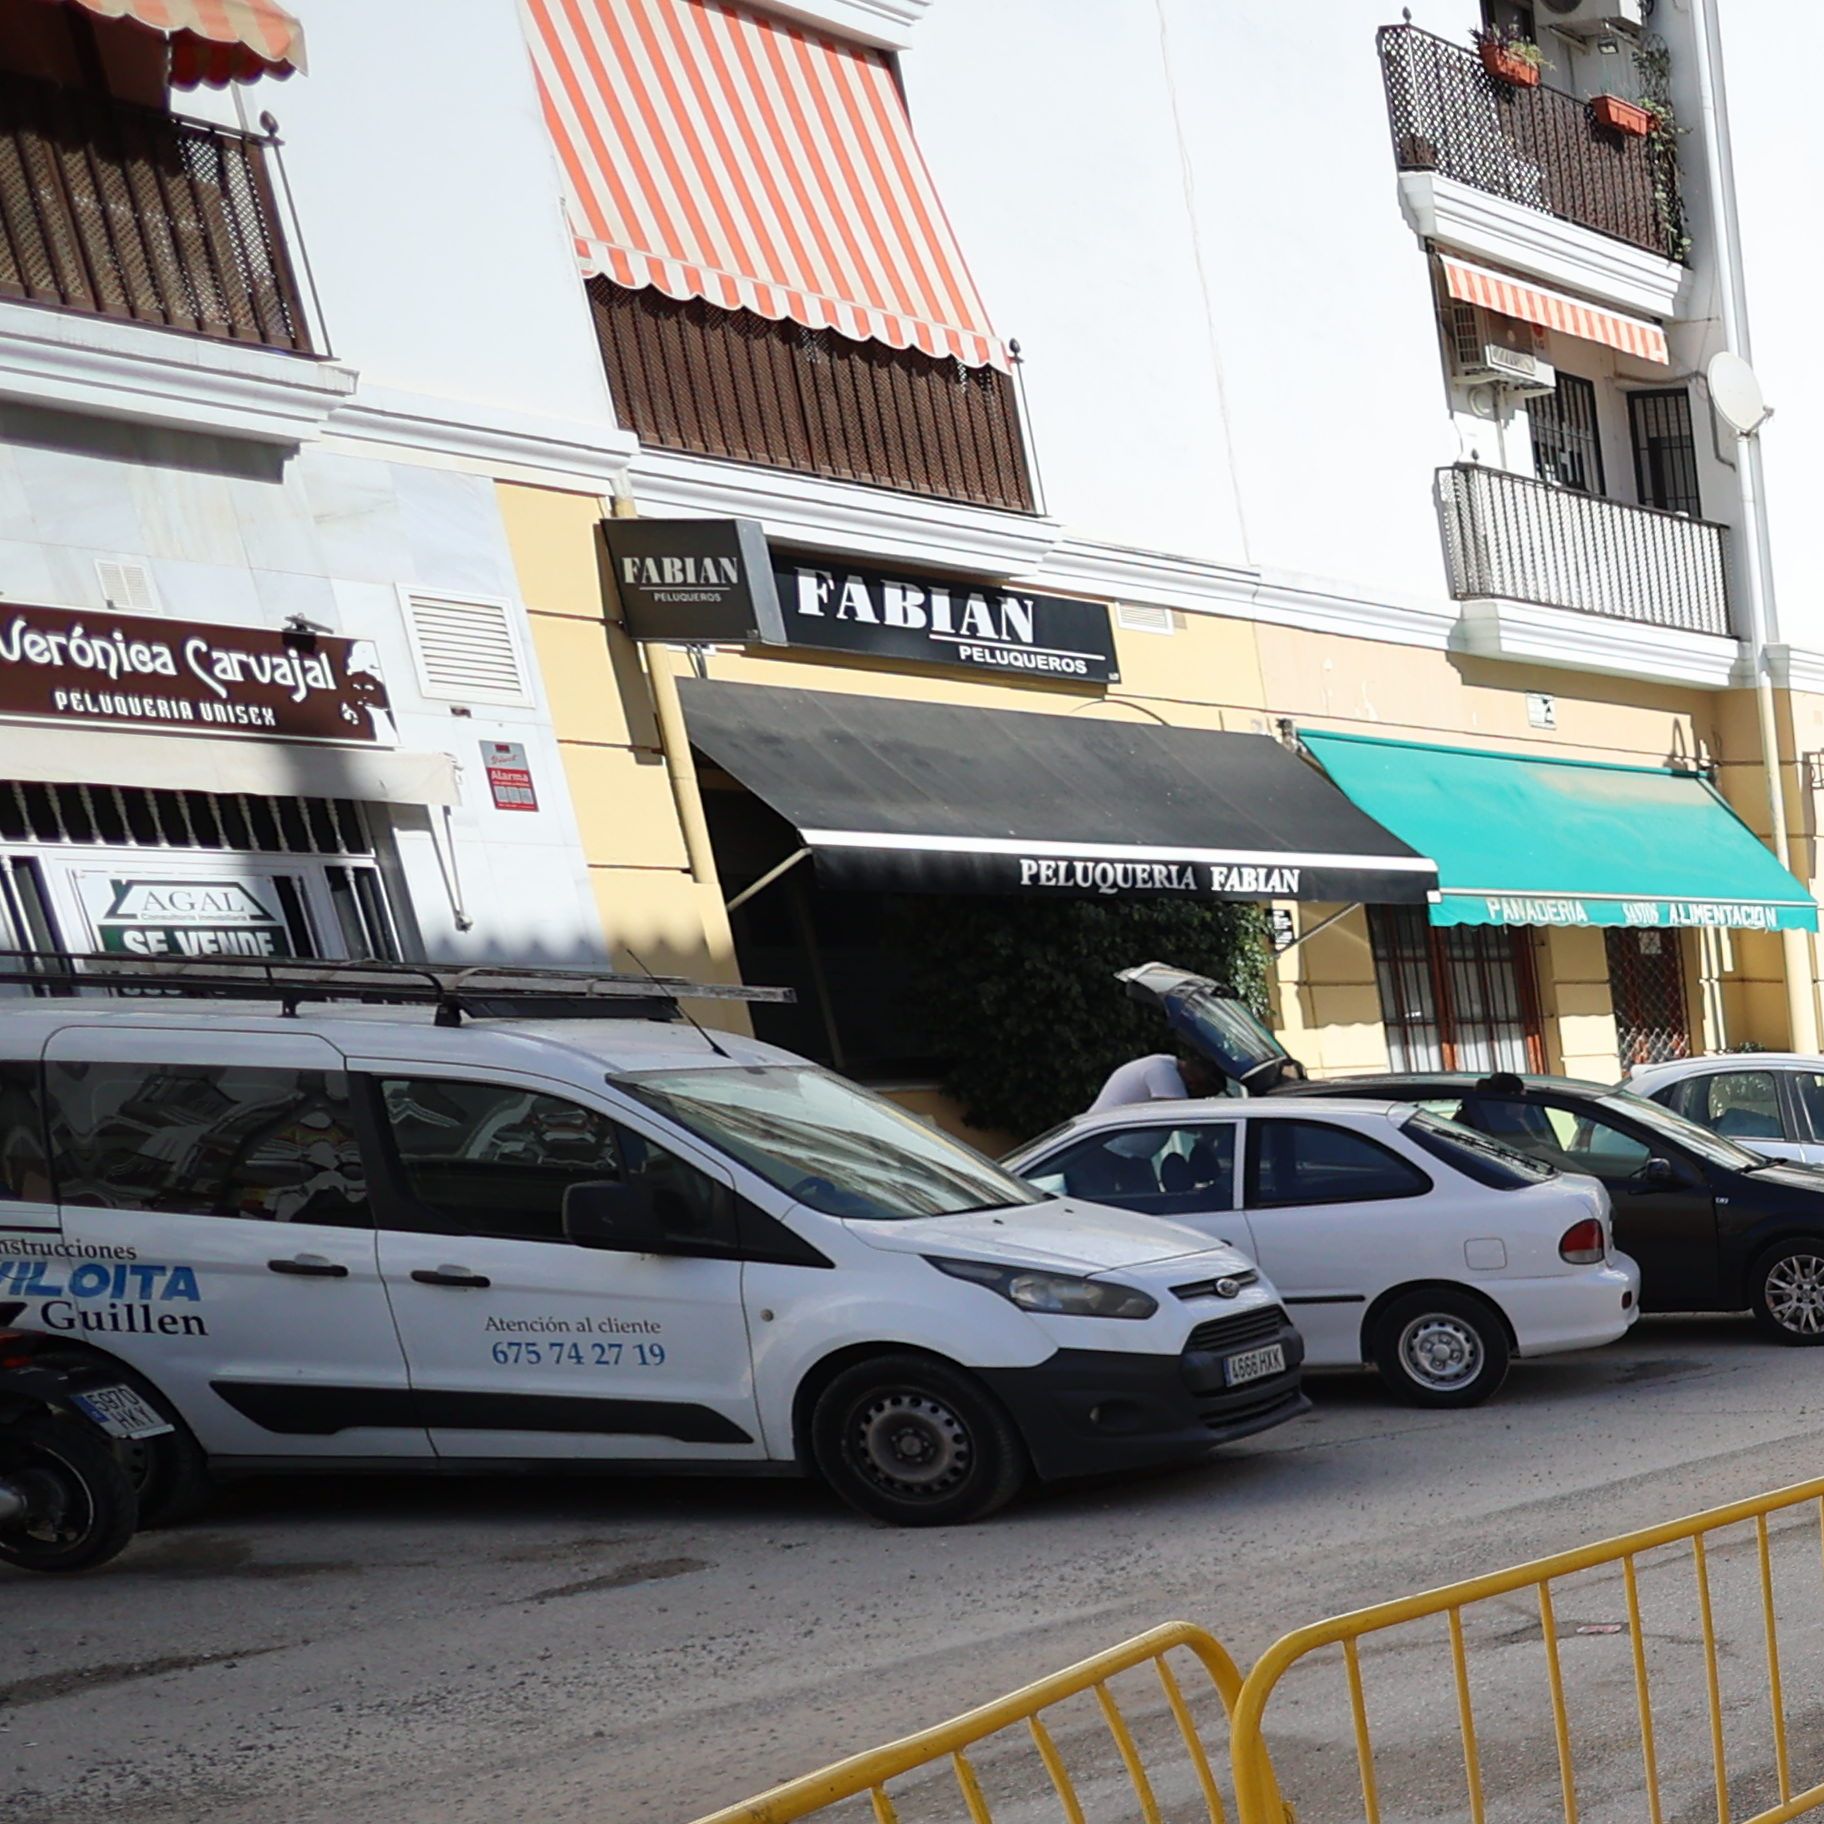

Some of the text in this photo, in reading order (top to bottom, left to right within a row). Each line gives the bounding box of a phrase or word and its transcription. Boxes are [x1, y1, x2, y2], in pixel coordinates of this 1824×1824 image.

[622, 557, 739, 584] FABIAN
[653, 592, 722, 602] PELUQUEROS
[794, 567, 1034, 643] FABIAN
[184, 638, 337, 702] Carvajal
[959, 645, 1088, 674] PELUQUEROS
[55, 690, 277, 727] PELUQUERIA UNISEX
[1020, 859, 1300, 894] PELUQUERIA FABIAN
[1485, 896, 1589, 922] PANADERIA
[1668, 903, 1778, 927] ALIMENTACION
[123, 930, 274, 957] SE VENDE
[41, 1301, 209, 1336] Guillen
[485, 1316, 661, 1334] Atención al cliente
[492, 1342, 665, 1366] 675 74 27 19
[86, 1388, 140, 1412] 5970
